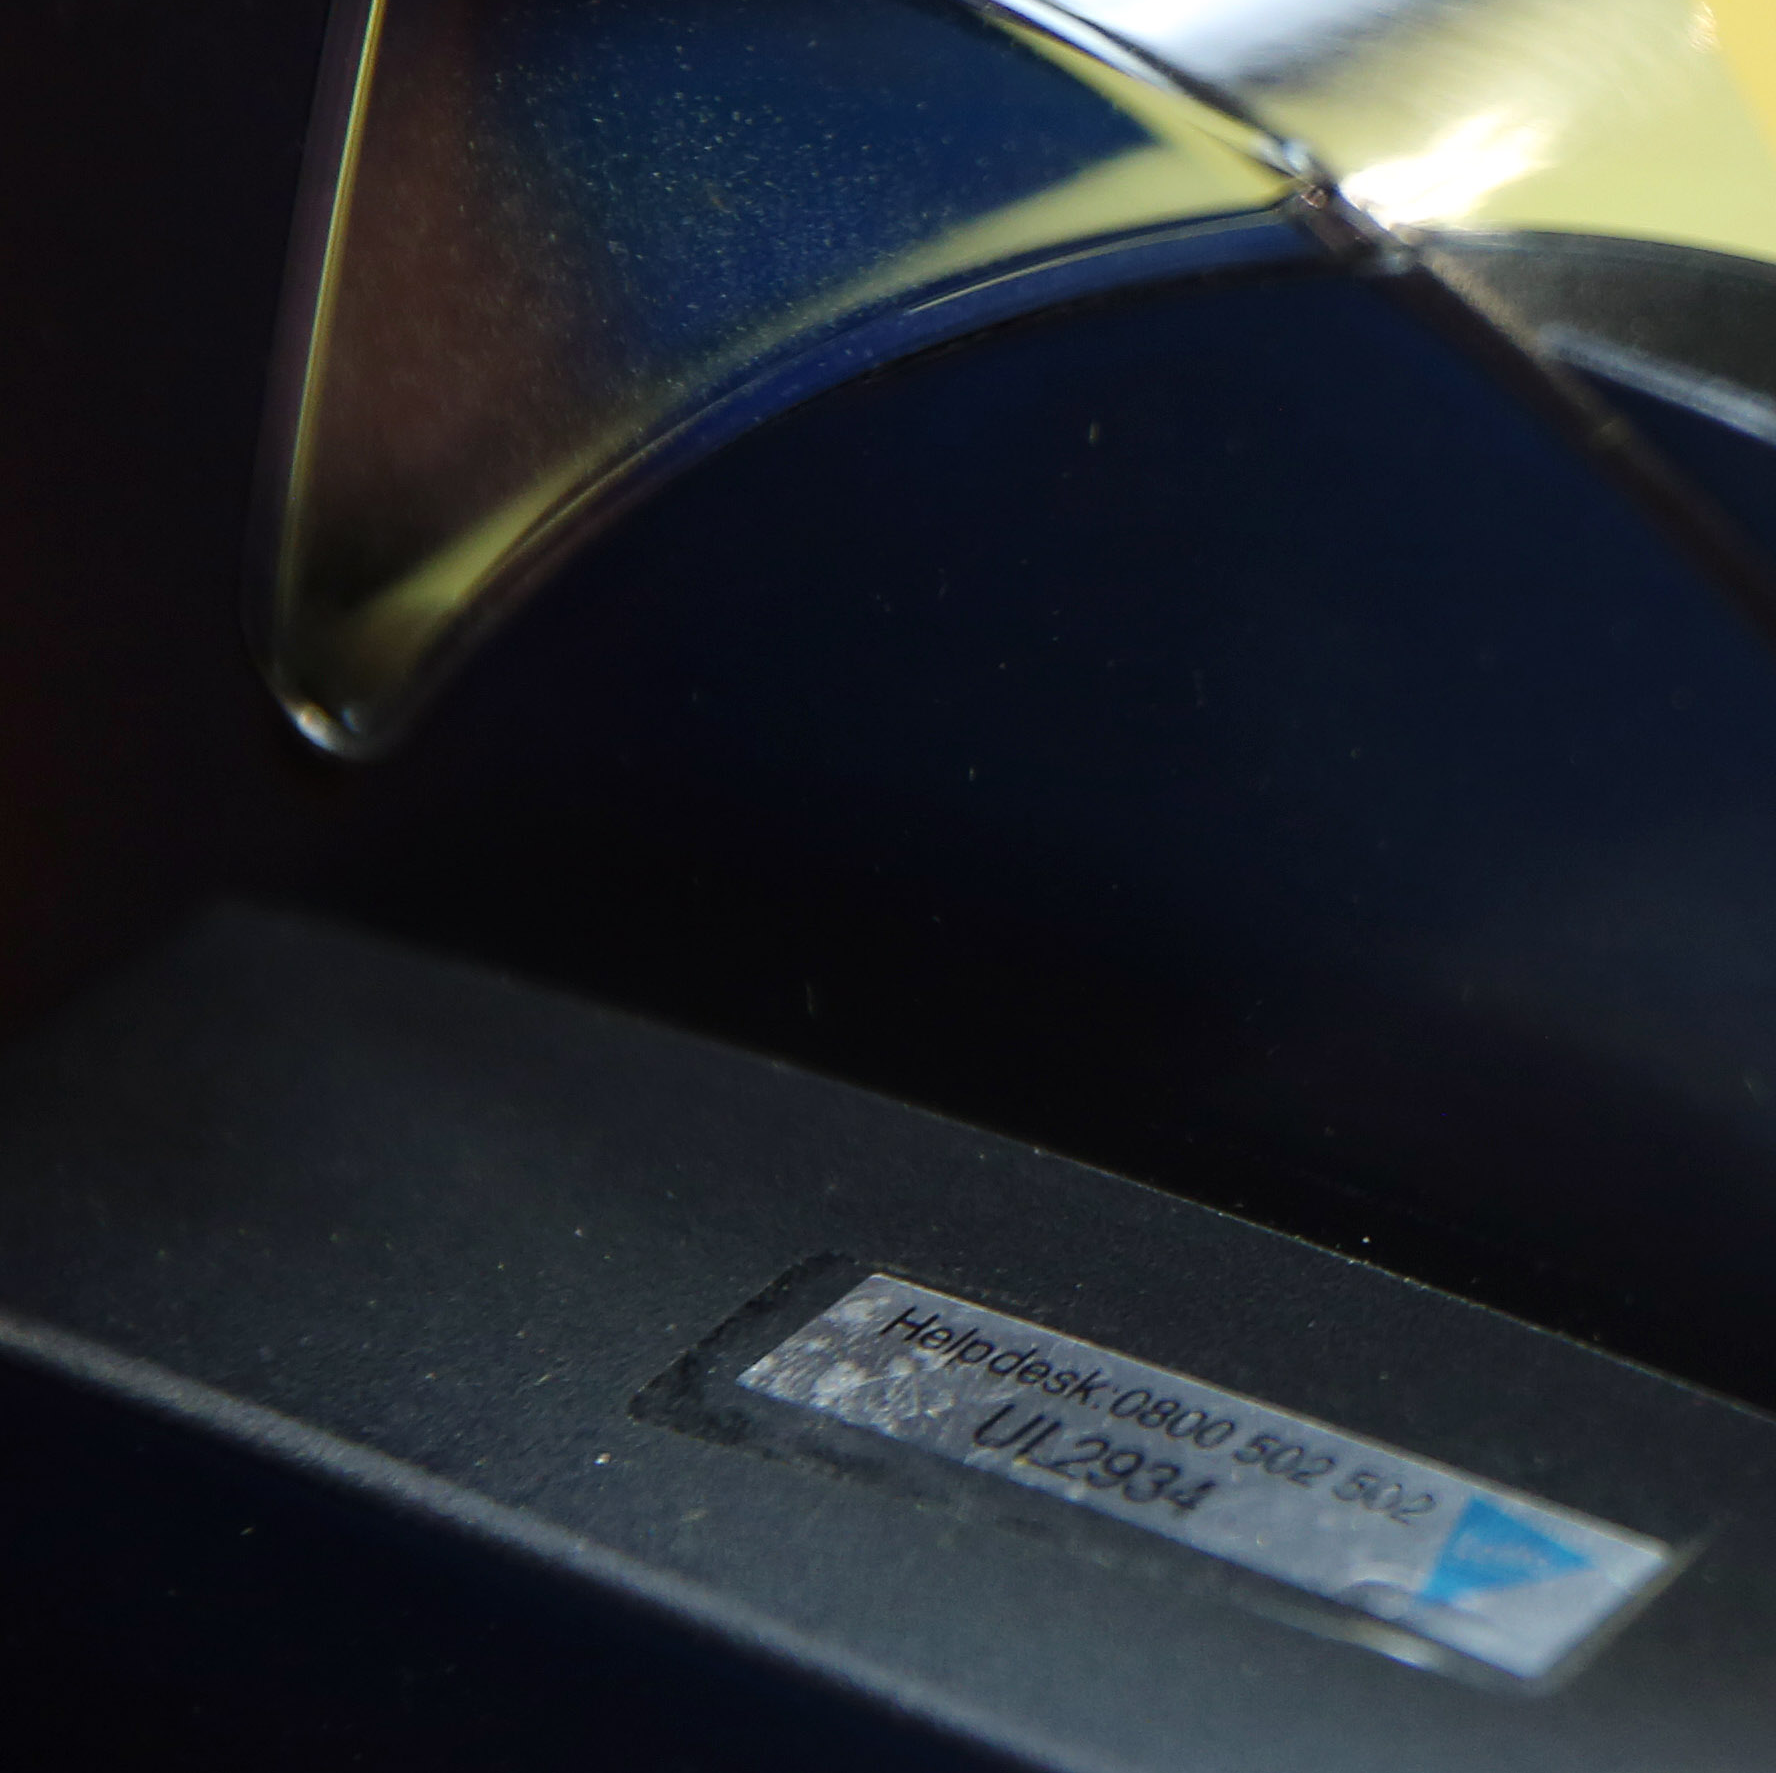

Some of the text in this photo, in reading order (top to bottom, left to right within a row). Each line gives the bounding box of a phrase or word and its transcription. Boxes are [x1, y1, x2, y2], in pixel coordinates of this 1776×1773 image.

[972, 1401, 1219, 1520] UL2934
[1234, 1434, 1335, 1490] 502
[1331, 1468, 1437, 1525] 502
